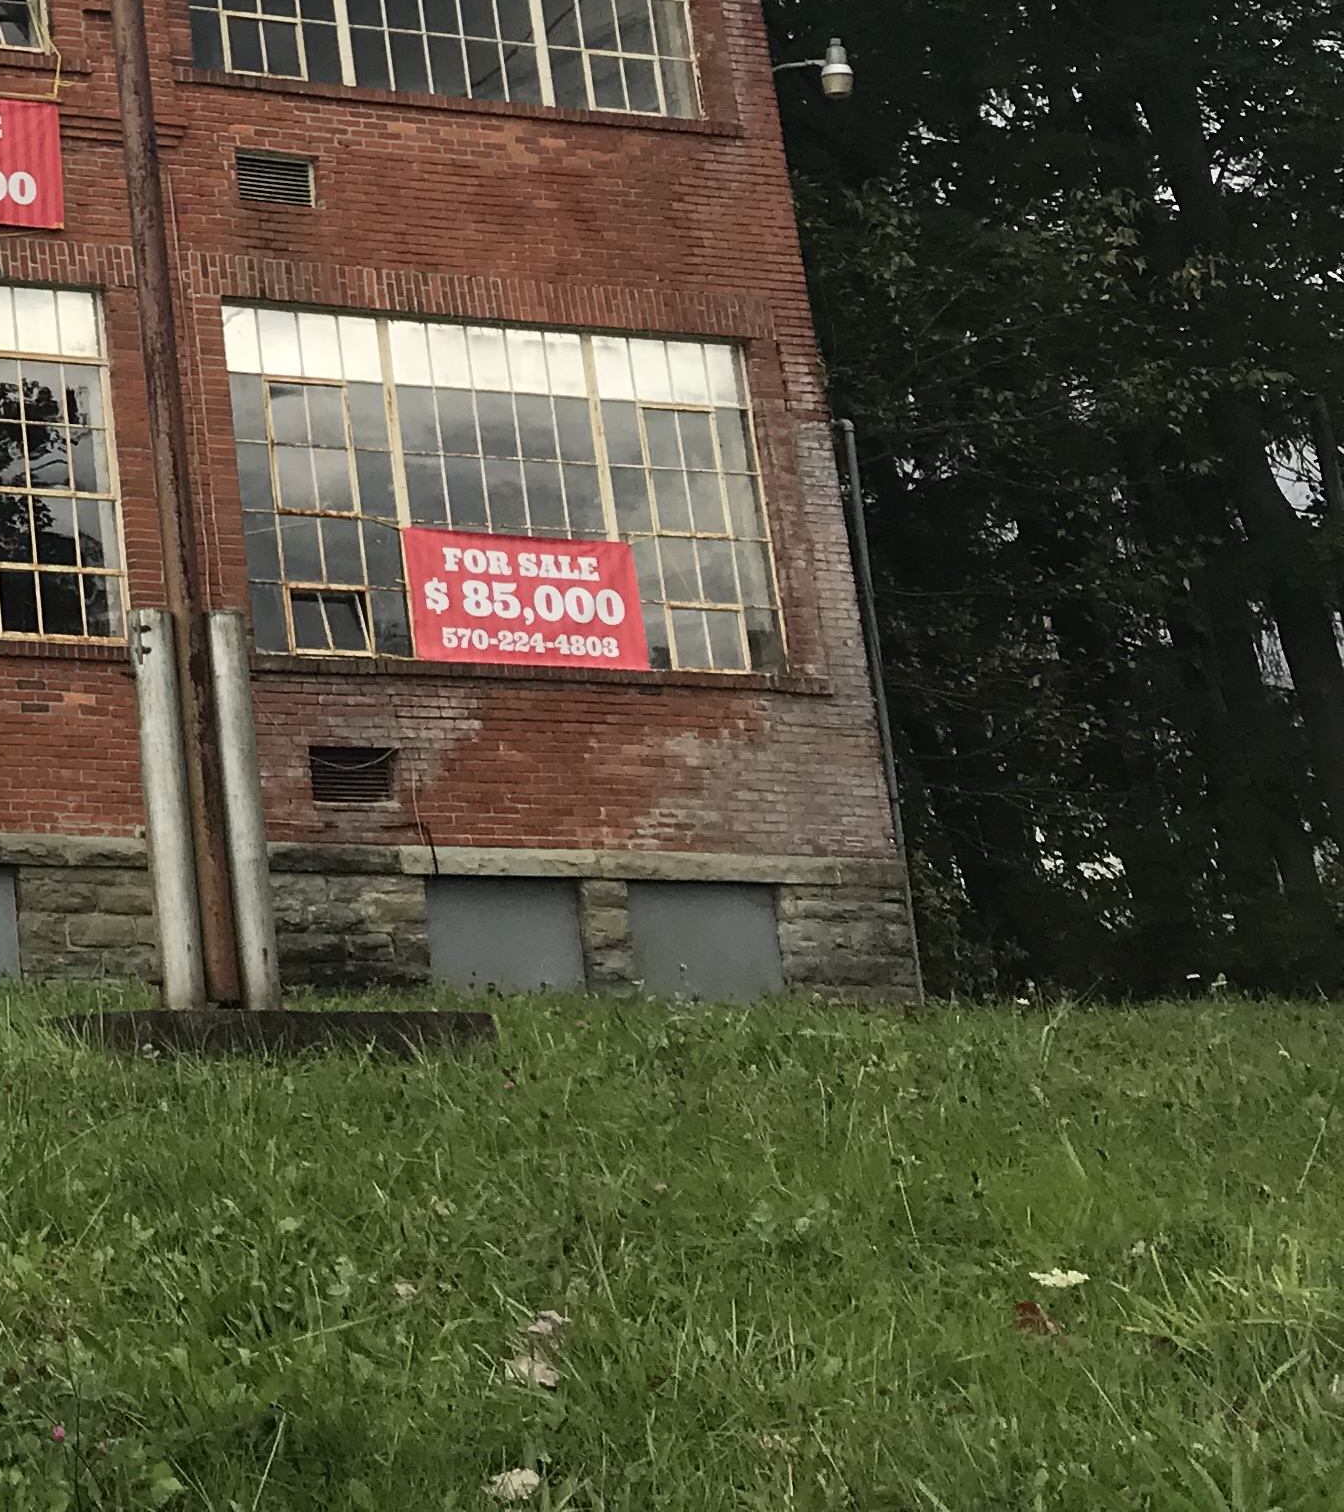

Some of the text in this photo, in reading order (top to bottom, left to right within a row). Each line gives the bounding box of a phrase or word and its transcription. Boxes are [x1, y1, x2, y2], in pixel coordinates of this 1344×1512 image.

[442, 547, 600, 581] FOR SALE
[424, 577, 625, 625] $ 85,000
[442, 627, 620, 657] 570-224-4803
